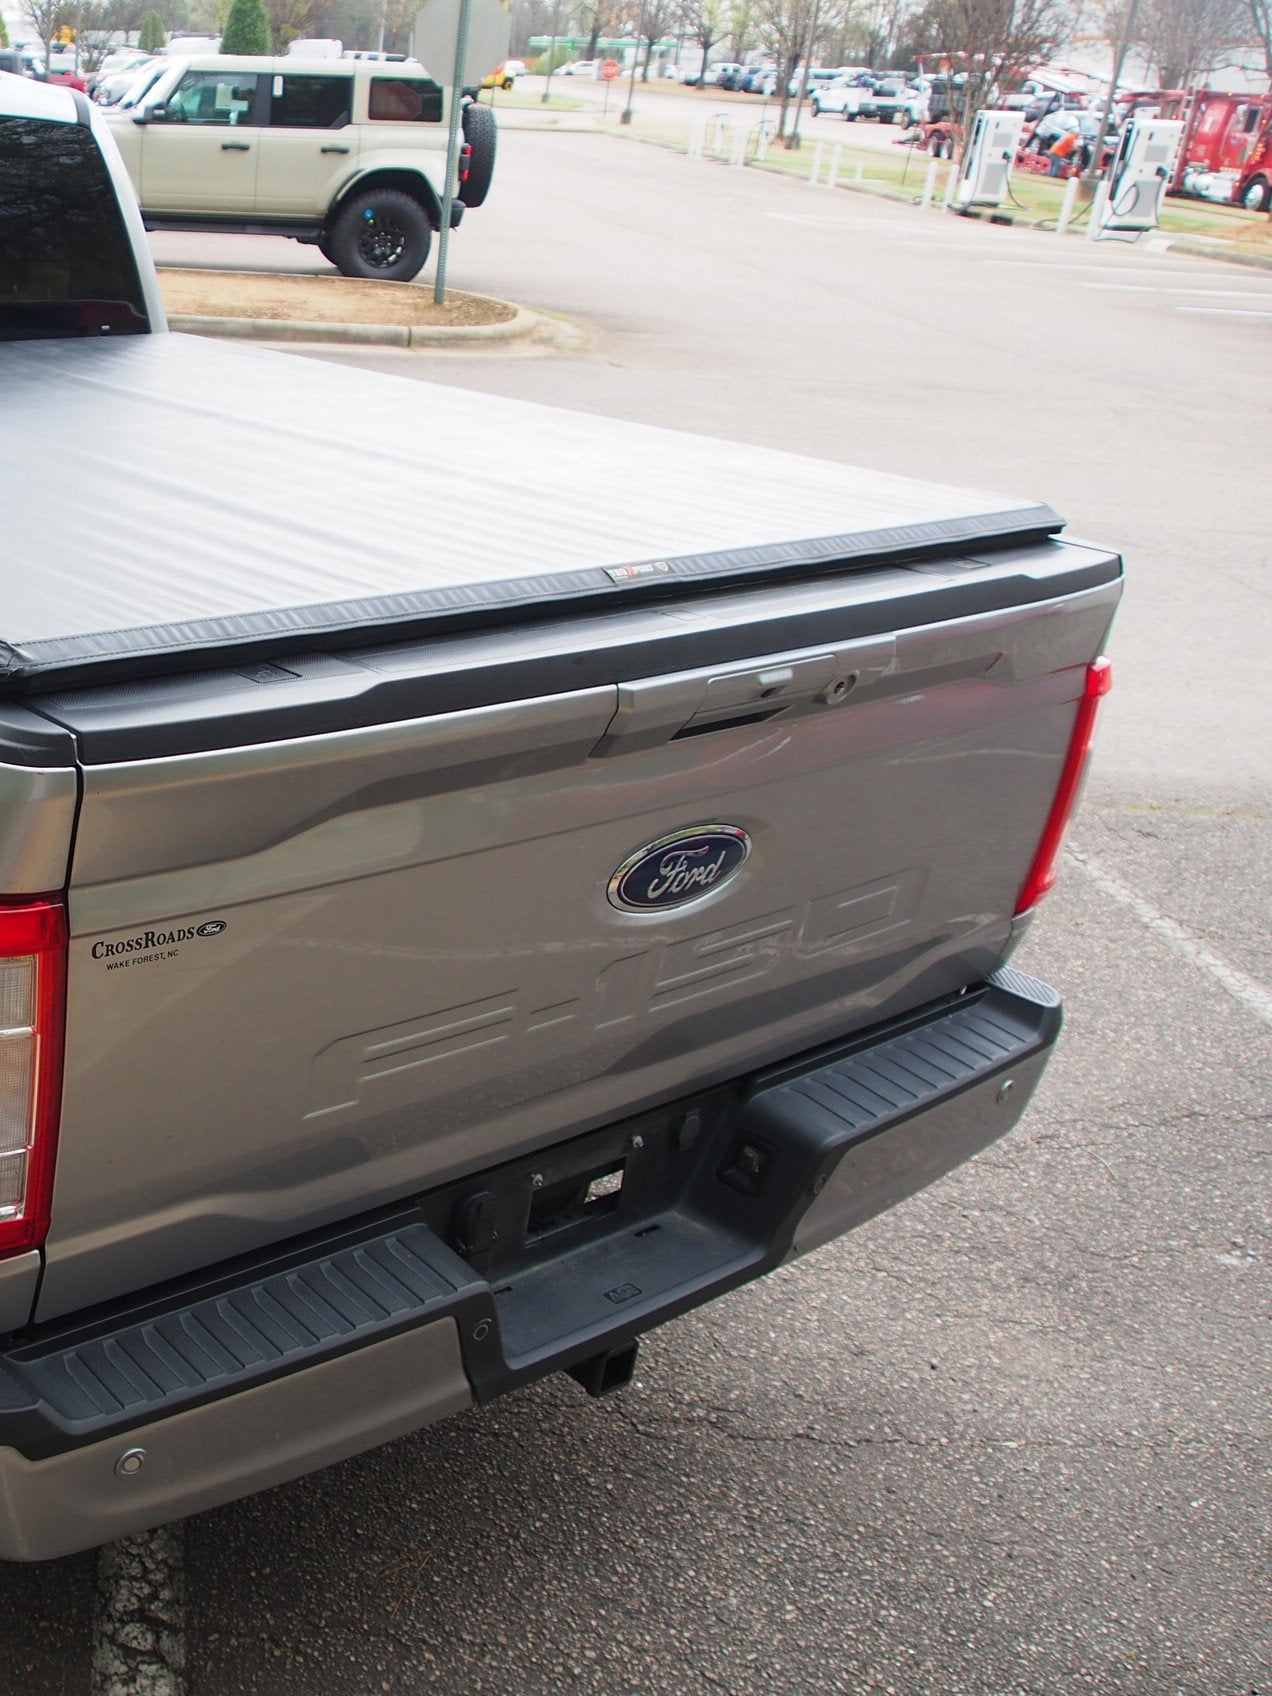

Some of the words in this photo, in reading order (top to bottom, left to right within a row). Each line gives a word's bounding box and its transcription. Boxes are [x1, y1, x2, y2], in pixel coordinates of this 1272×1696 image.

[602, 65, 618, 73] STOP
[647, 845, 727, 900] Ford
[106, 960, 131, 971] WAKE
[132, 952, 166, 967] FOREST,
[167, 949, 180, 958] NC
[302, 865, 929, 1120] F-150
